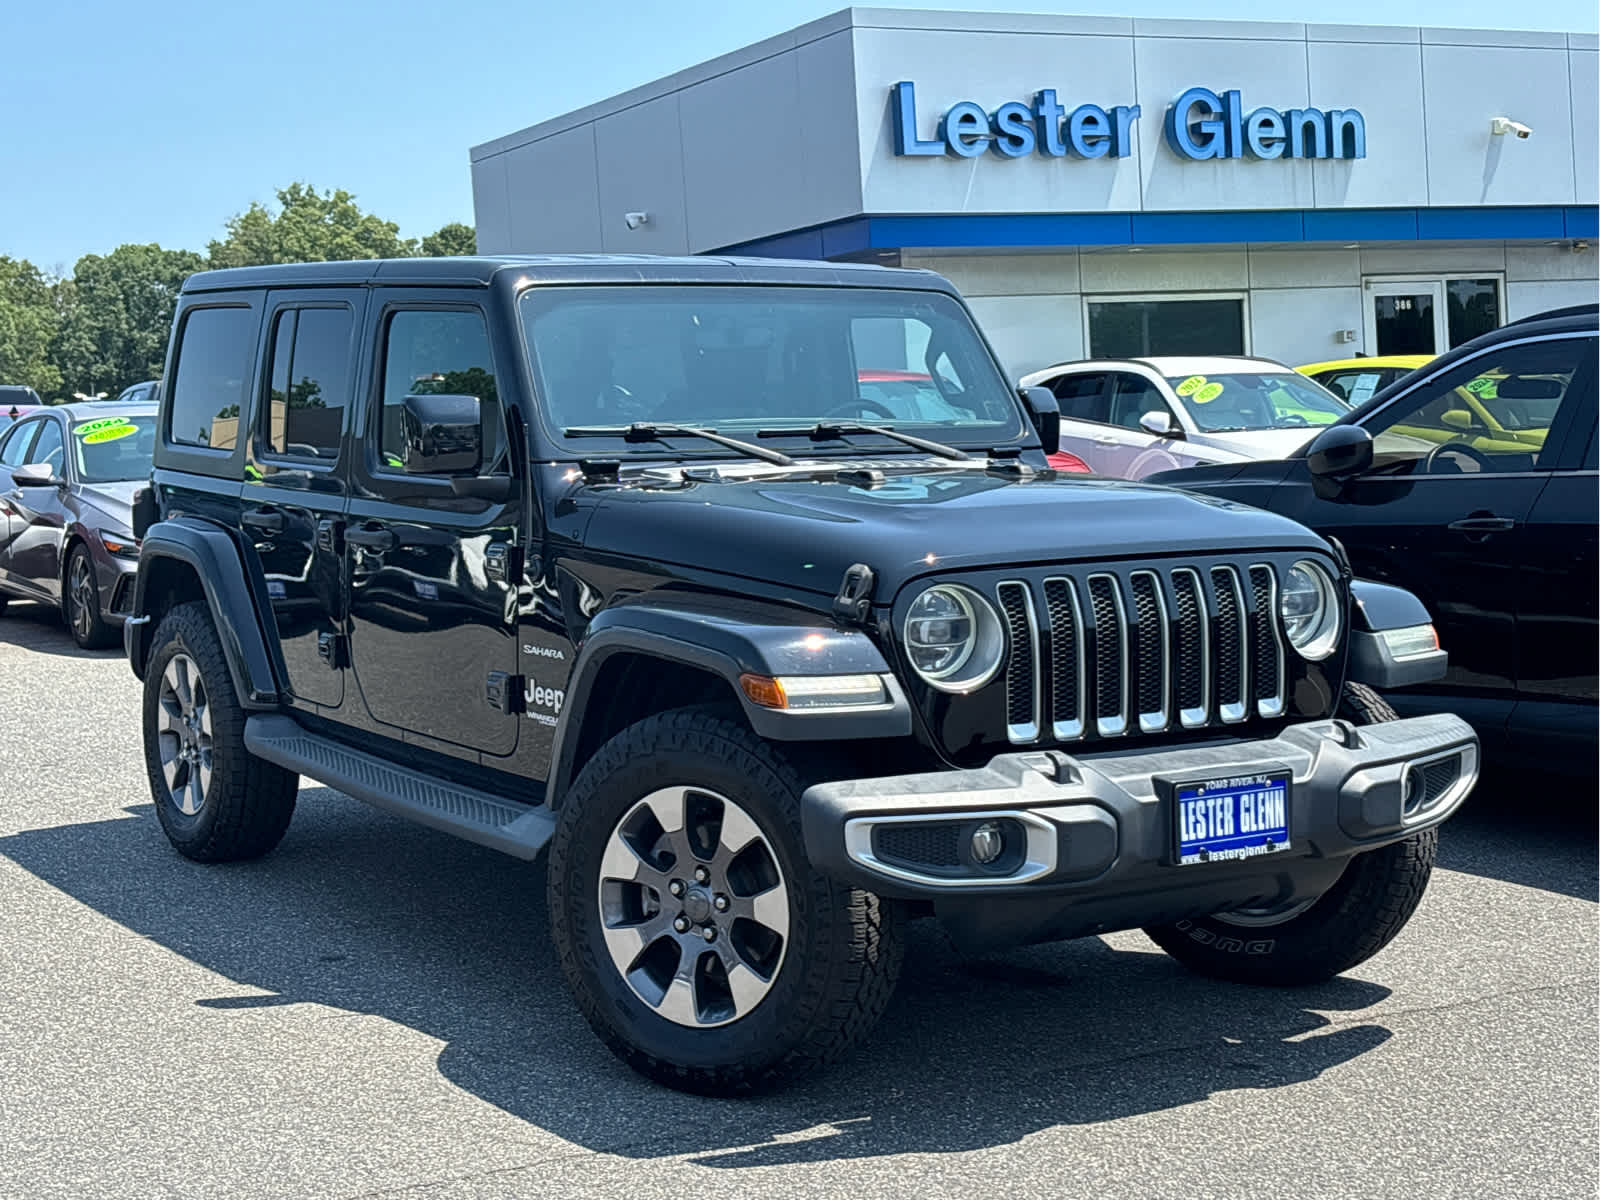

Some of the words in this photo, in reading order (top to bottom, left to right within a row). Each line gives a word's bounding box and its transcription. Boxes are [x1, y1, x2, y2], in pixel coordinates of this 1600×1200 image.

[894, 81, 1141, 159] Lester
[1166, 87, 1366, 160] Glenn
[81, 418, 124, 433] 2024
[523, 644, 564, 660] SAHARA
[524, 678, 564, 714] Jeep
[1206, 778, 1228, 791] TOMS
[1180, 796, 1234, 842] LESTER
[1240, 789, 1285, 833] GLENN
